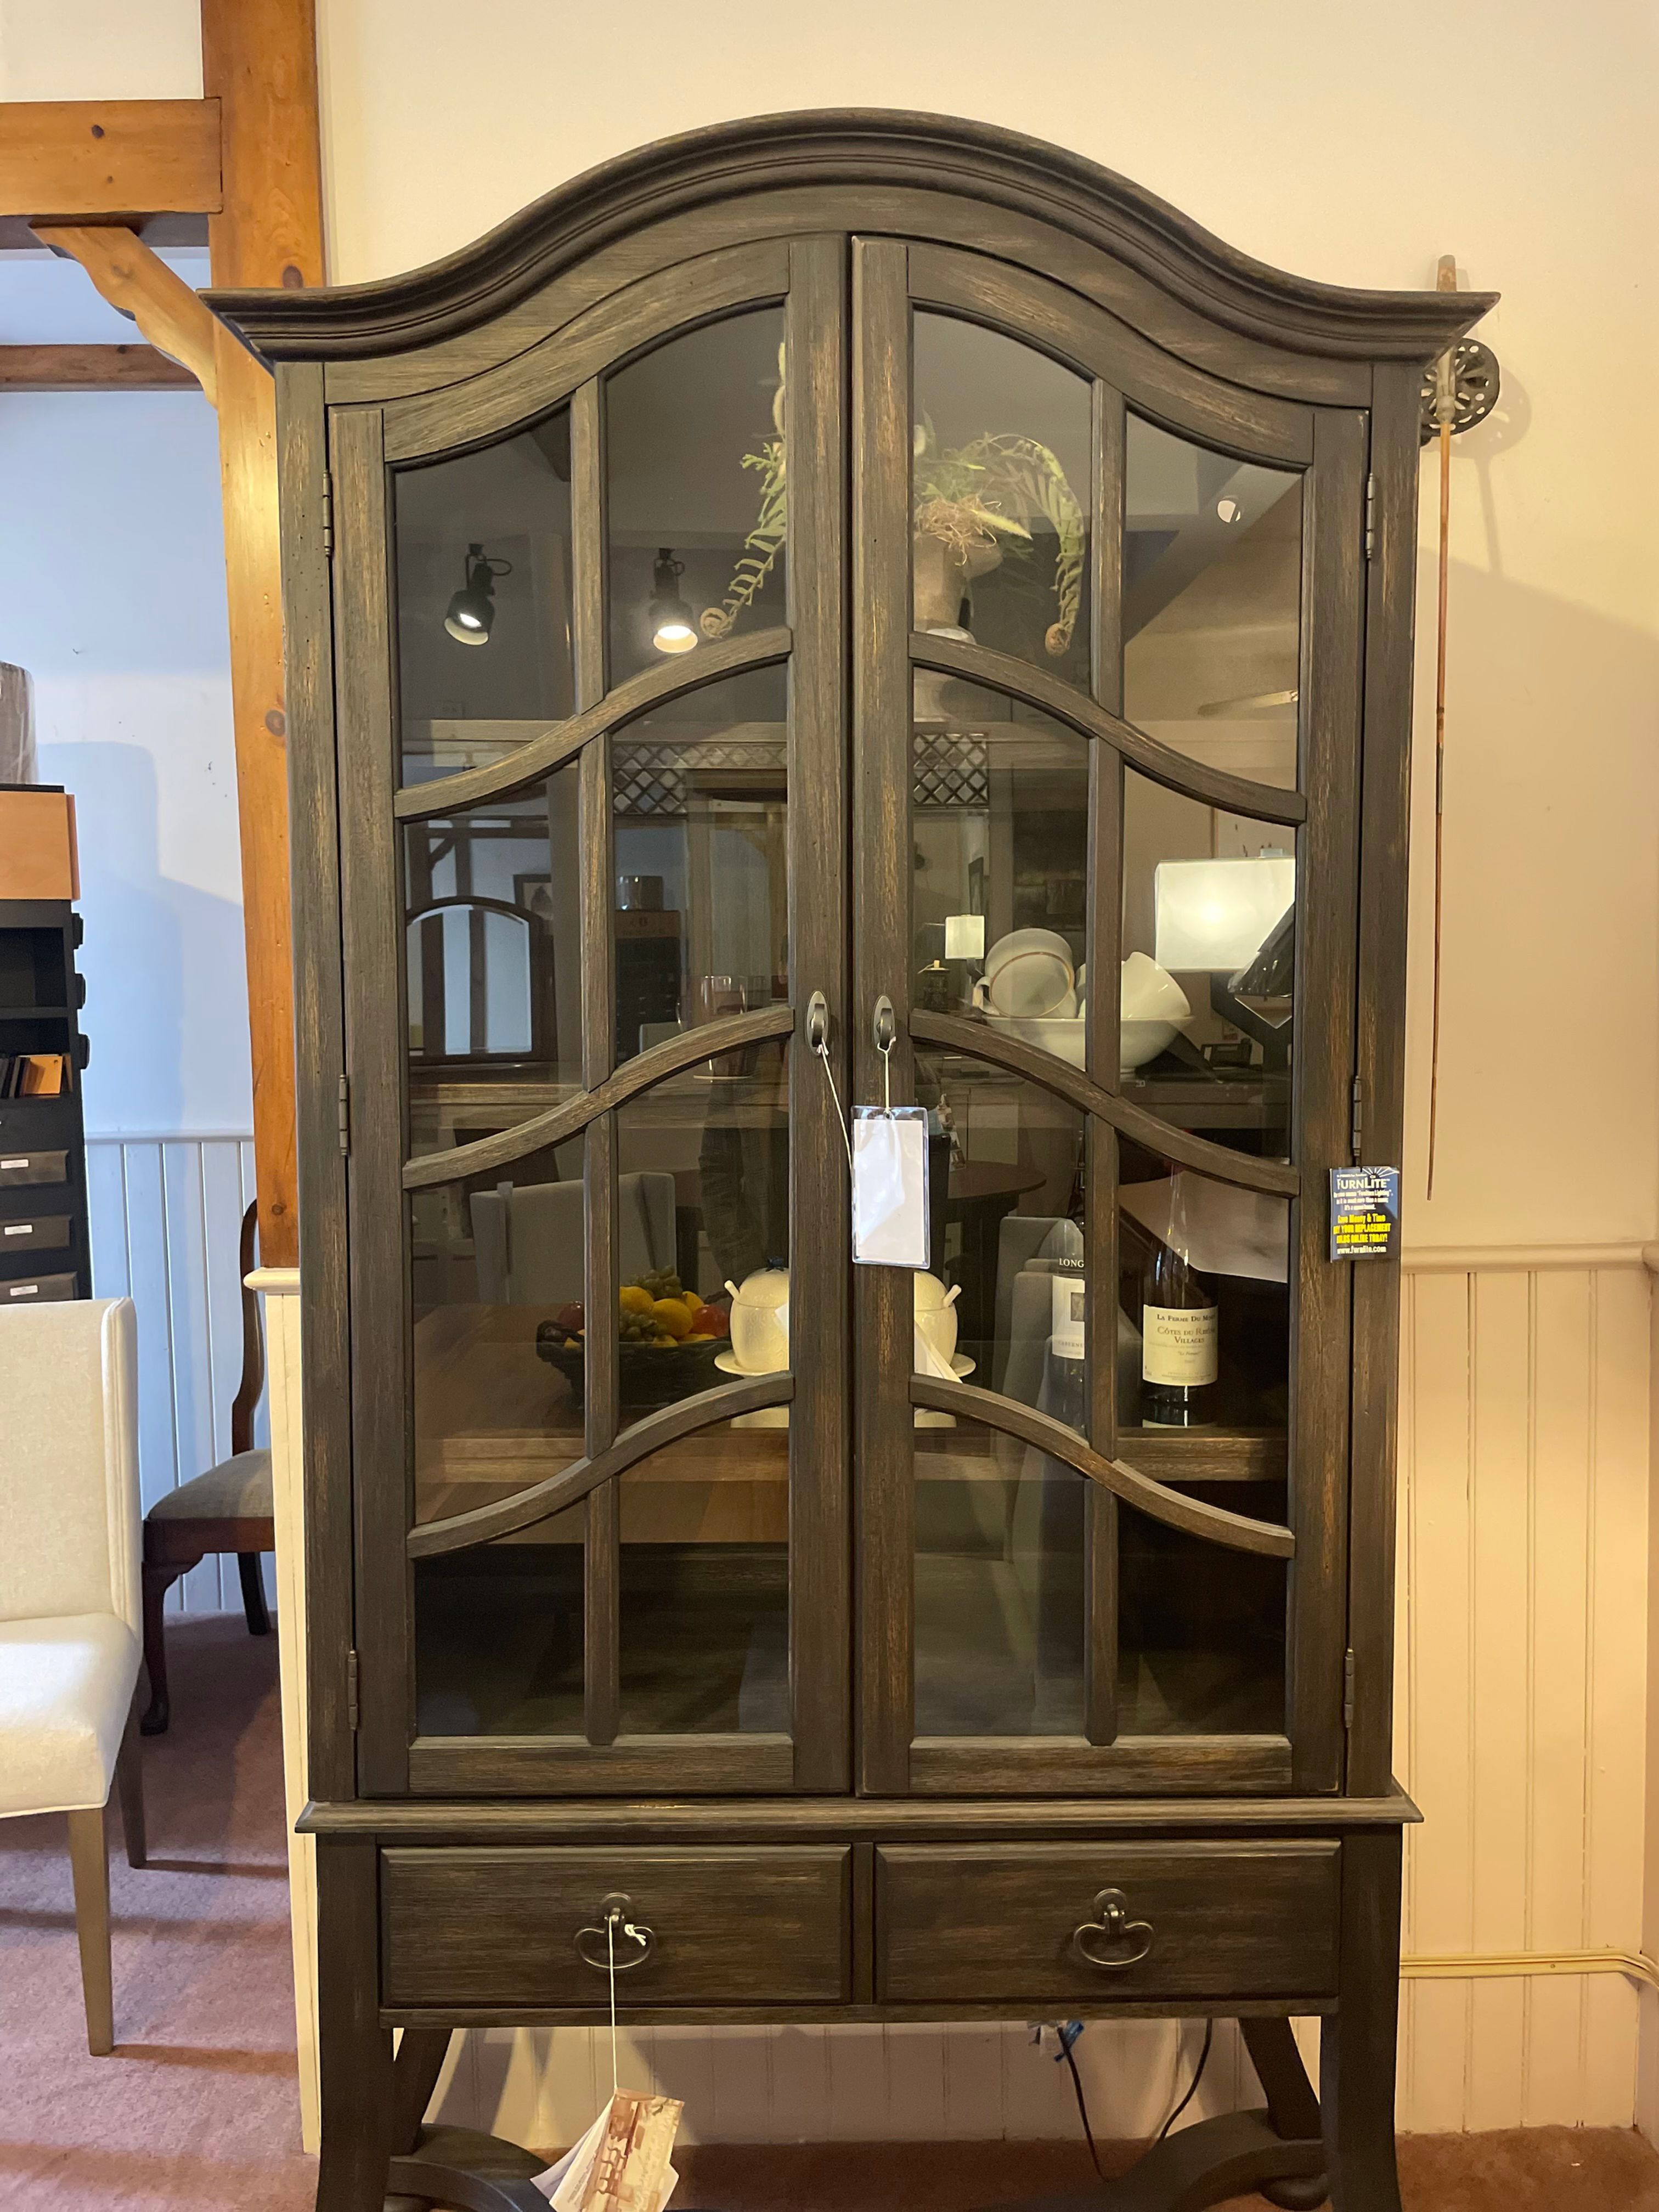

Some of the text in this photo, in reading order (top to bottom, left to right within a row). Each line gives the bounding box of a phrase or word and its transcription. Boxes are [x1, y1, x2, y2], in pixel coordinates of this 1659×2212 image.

[1372, 1213, 1386, 1222] Time
[1355, 1223, 1391, 1233] REPLACEMENT
[1059, 1257, 1084, 1268] LONG
